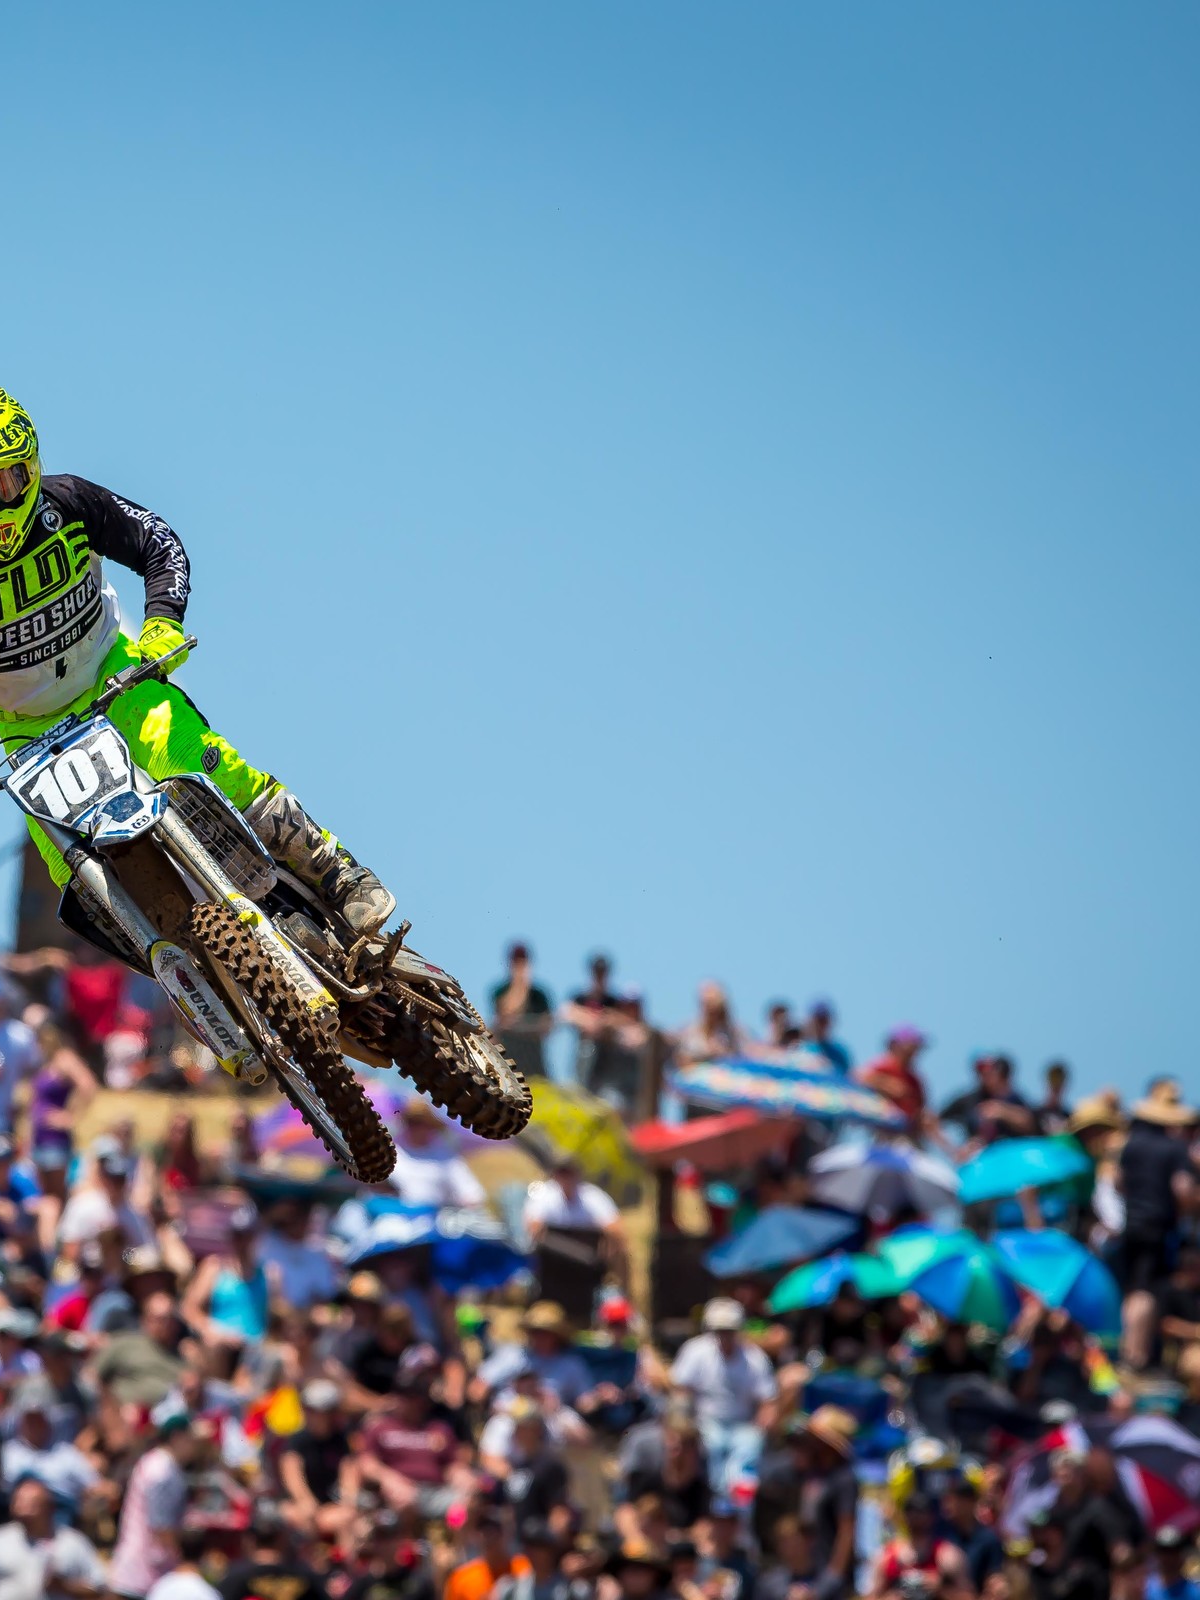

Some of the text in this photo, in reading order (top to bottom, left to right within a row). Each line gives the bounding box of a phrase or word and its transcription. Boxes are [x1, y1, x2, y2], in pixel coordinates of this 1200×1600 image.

[51, 575, 97, 628] SHOP
[20, 624, 82, 665] SINCE 1981
[29, 729, 128, 821] 101
[177, 974, 240, 1050] DUNLOP
